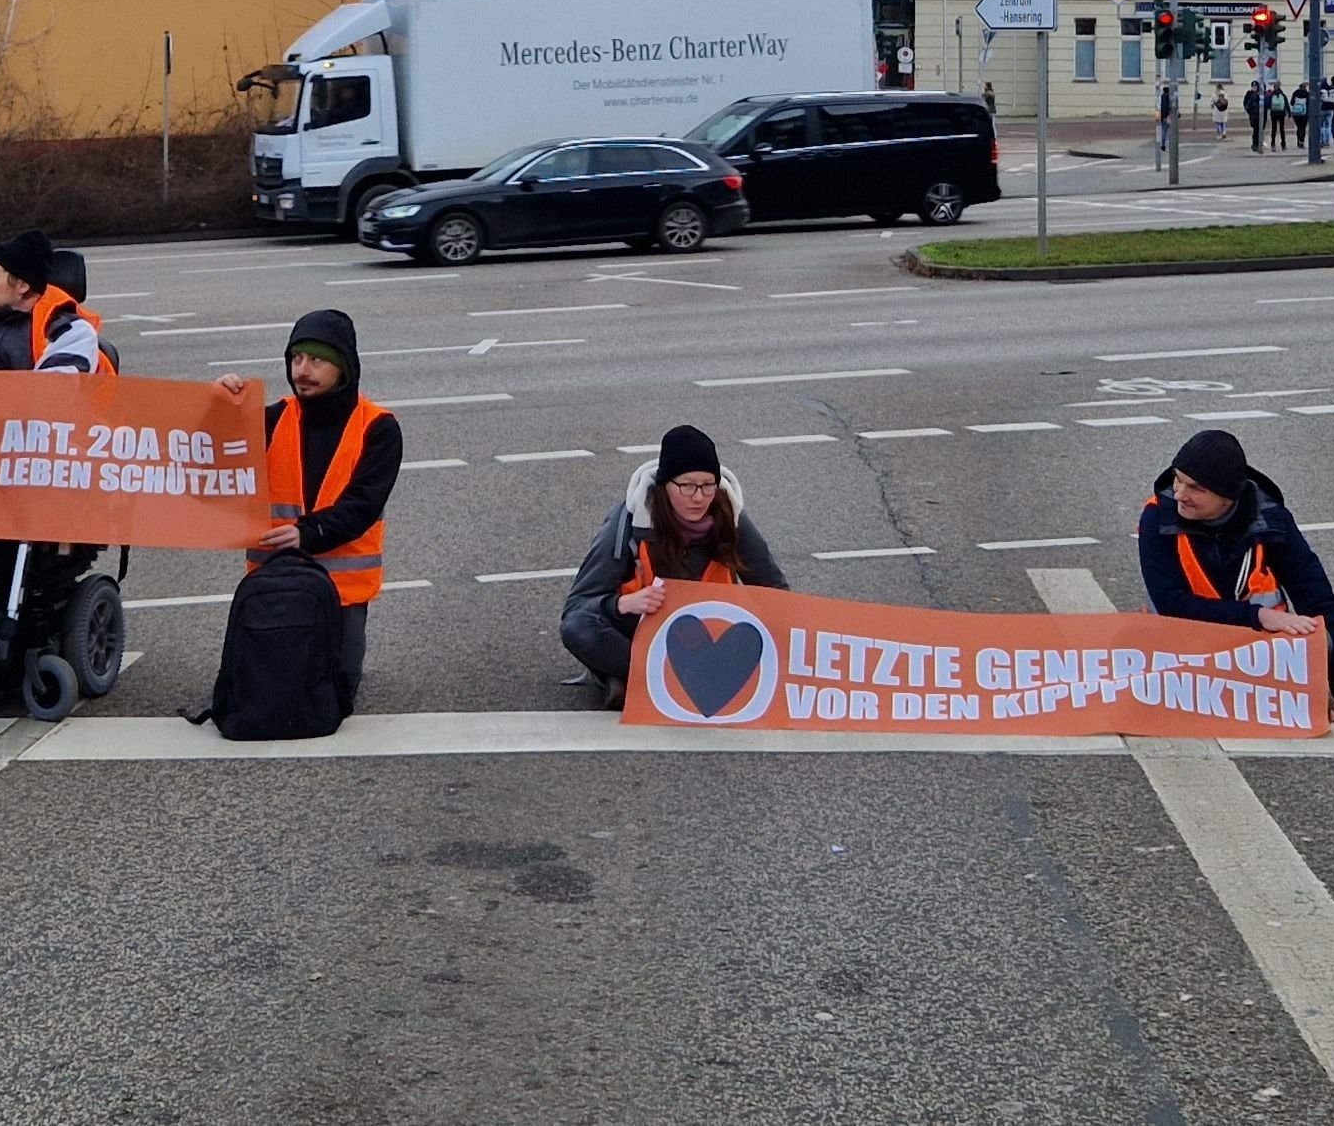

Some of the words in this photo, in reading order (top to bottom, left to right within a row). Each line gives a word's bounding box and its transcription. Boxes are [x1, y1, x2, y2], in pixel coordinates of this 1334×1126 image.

[999, 10, 1043, 26] -Hansering
[499, 38, 662, 66] Mercedes-Benz
[668, 32, 790, 61] CharterWay
[573, 78, 590, 90] Der
[603, 93, 698, 108] www.charterway.de
[0, 420, 78, 456] ART.
[86, 425, 160, 460] 20A
[168, 429, 214, 464] GG
[99, 462, 256, 495] SCHÜTZEN
[788, 627, 962, 688] LETZTE
[785, 683, 879, 720] VOR
[892, 692, 980, 720] DEN
[992, 670, 1312, 730] KIPPPUNKTEN
